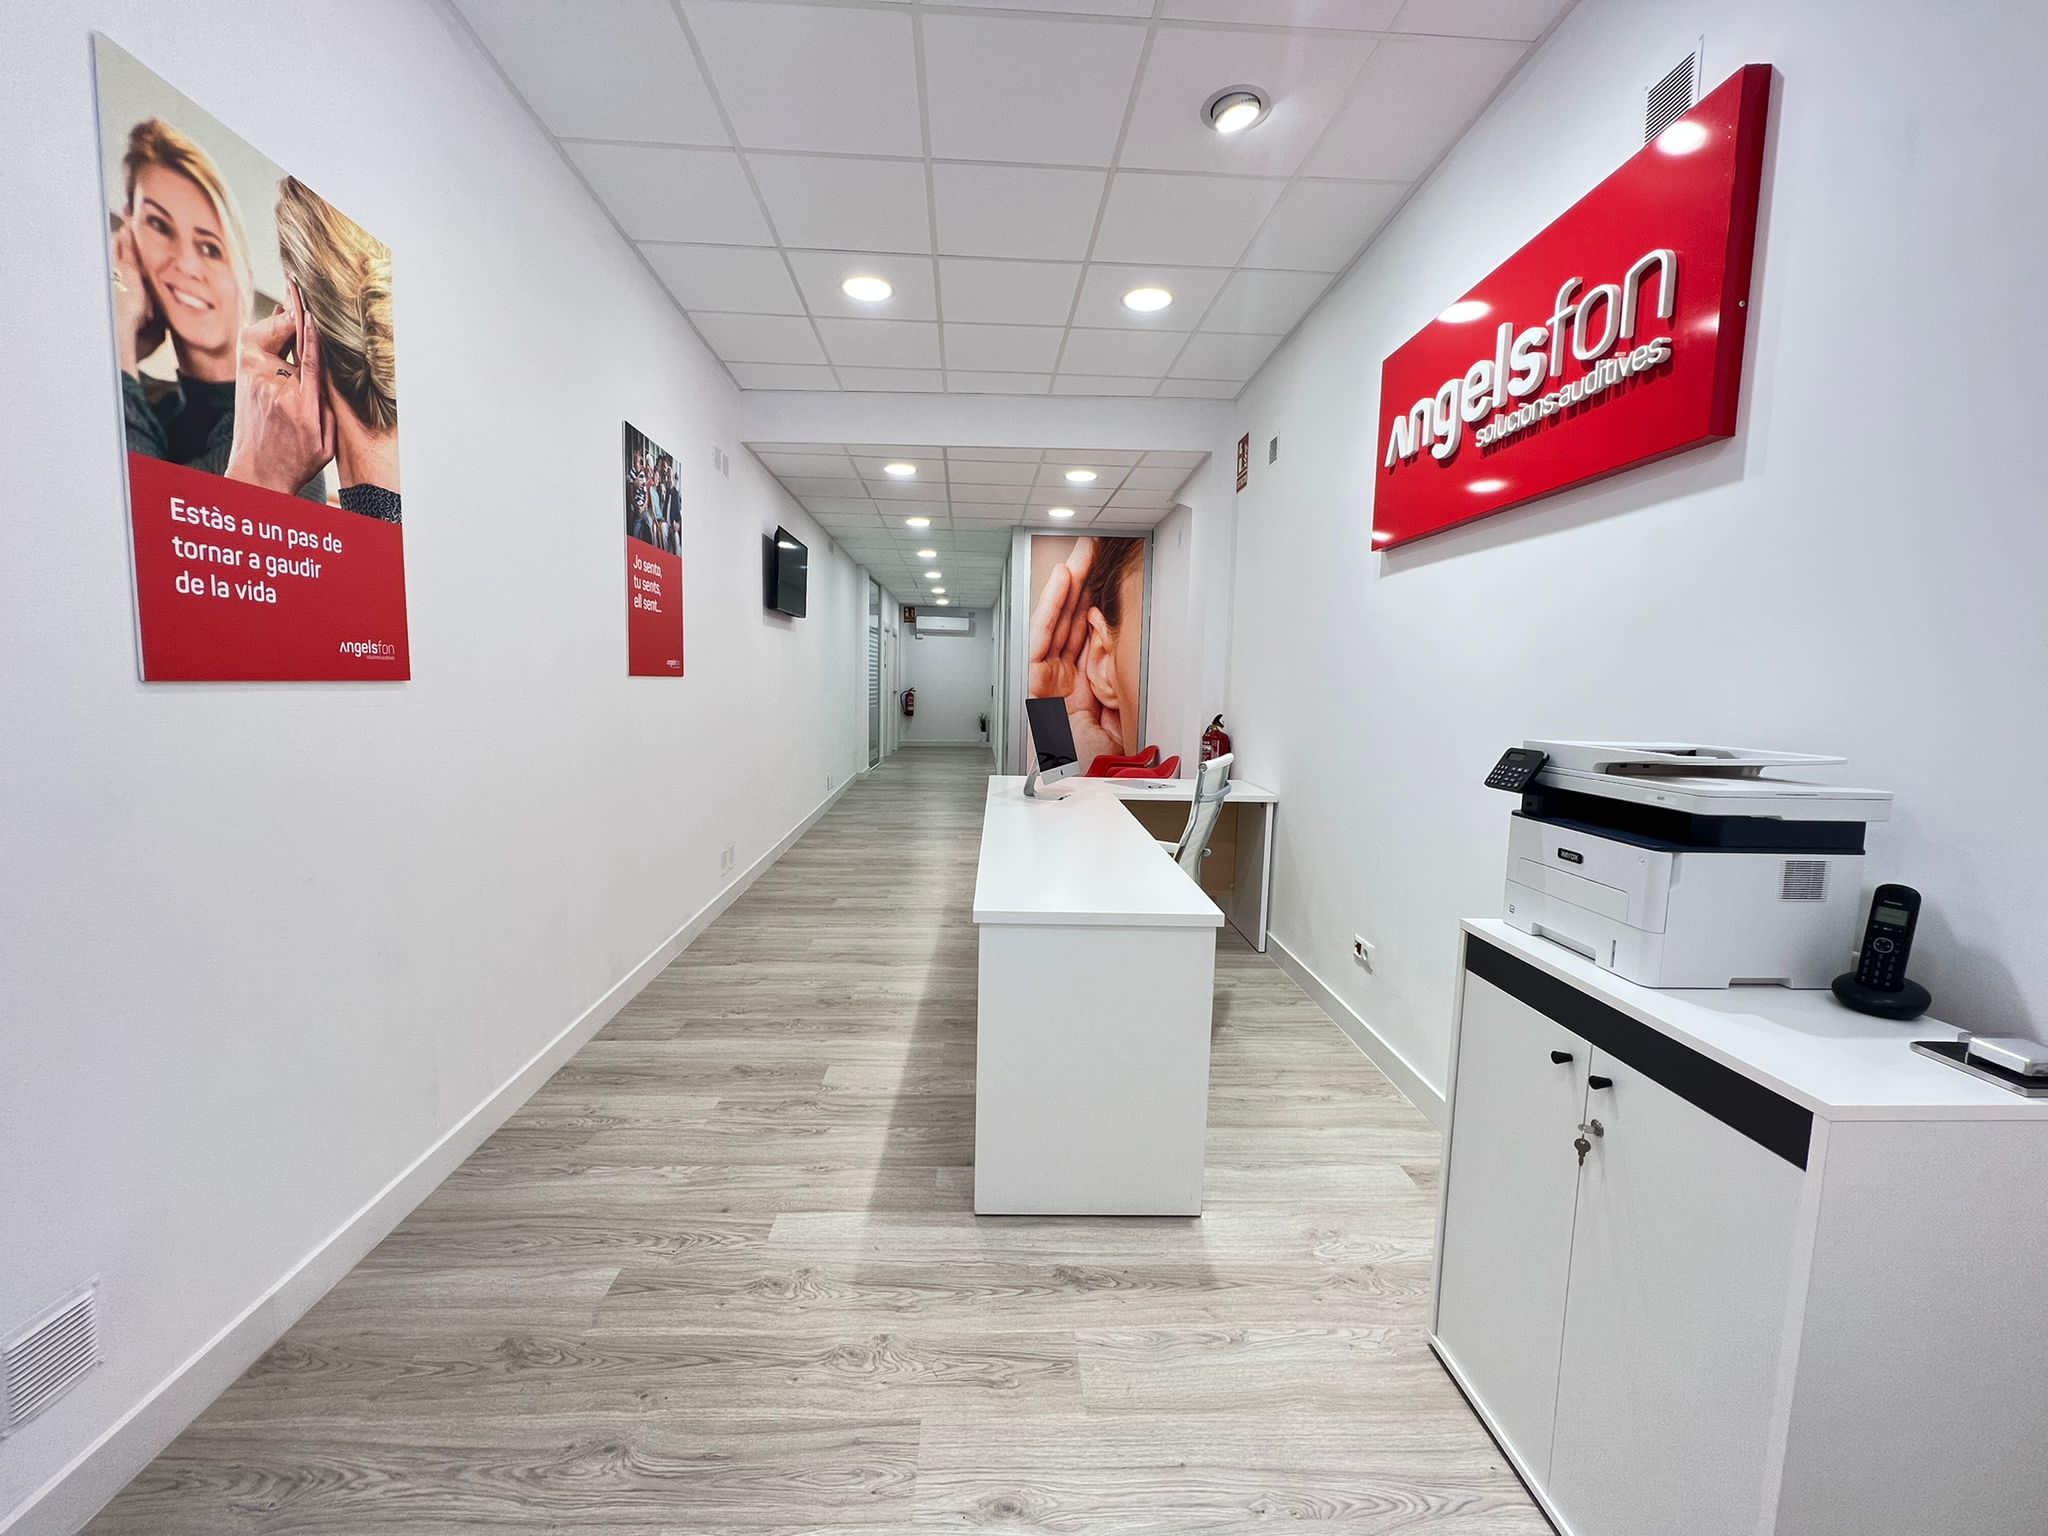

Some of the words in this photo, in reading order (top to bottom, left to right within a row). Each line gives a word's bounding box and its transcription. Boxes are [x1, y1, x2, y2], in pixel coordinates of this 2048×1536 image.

[170, 497, 236, 532] Estàs
[241, 518, 253, 536] a
[258, 522, 283, 541] un
[288, 528, 319, 550] pas
[323, 531, 343, 554] de
[172, 535, 243, 566] tornar
[248, 551, 260, 569] a
[266, 555, 322, 578] gaudir
[633, 554, 642, 570] Jo
[175, 571, 204, 595] de
[211, 575, 230, 598] la
[234, 580, 278, 603] vida
[633, 575, 642, 589] tu
[633, 593, 643, 609] ell
